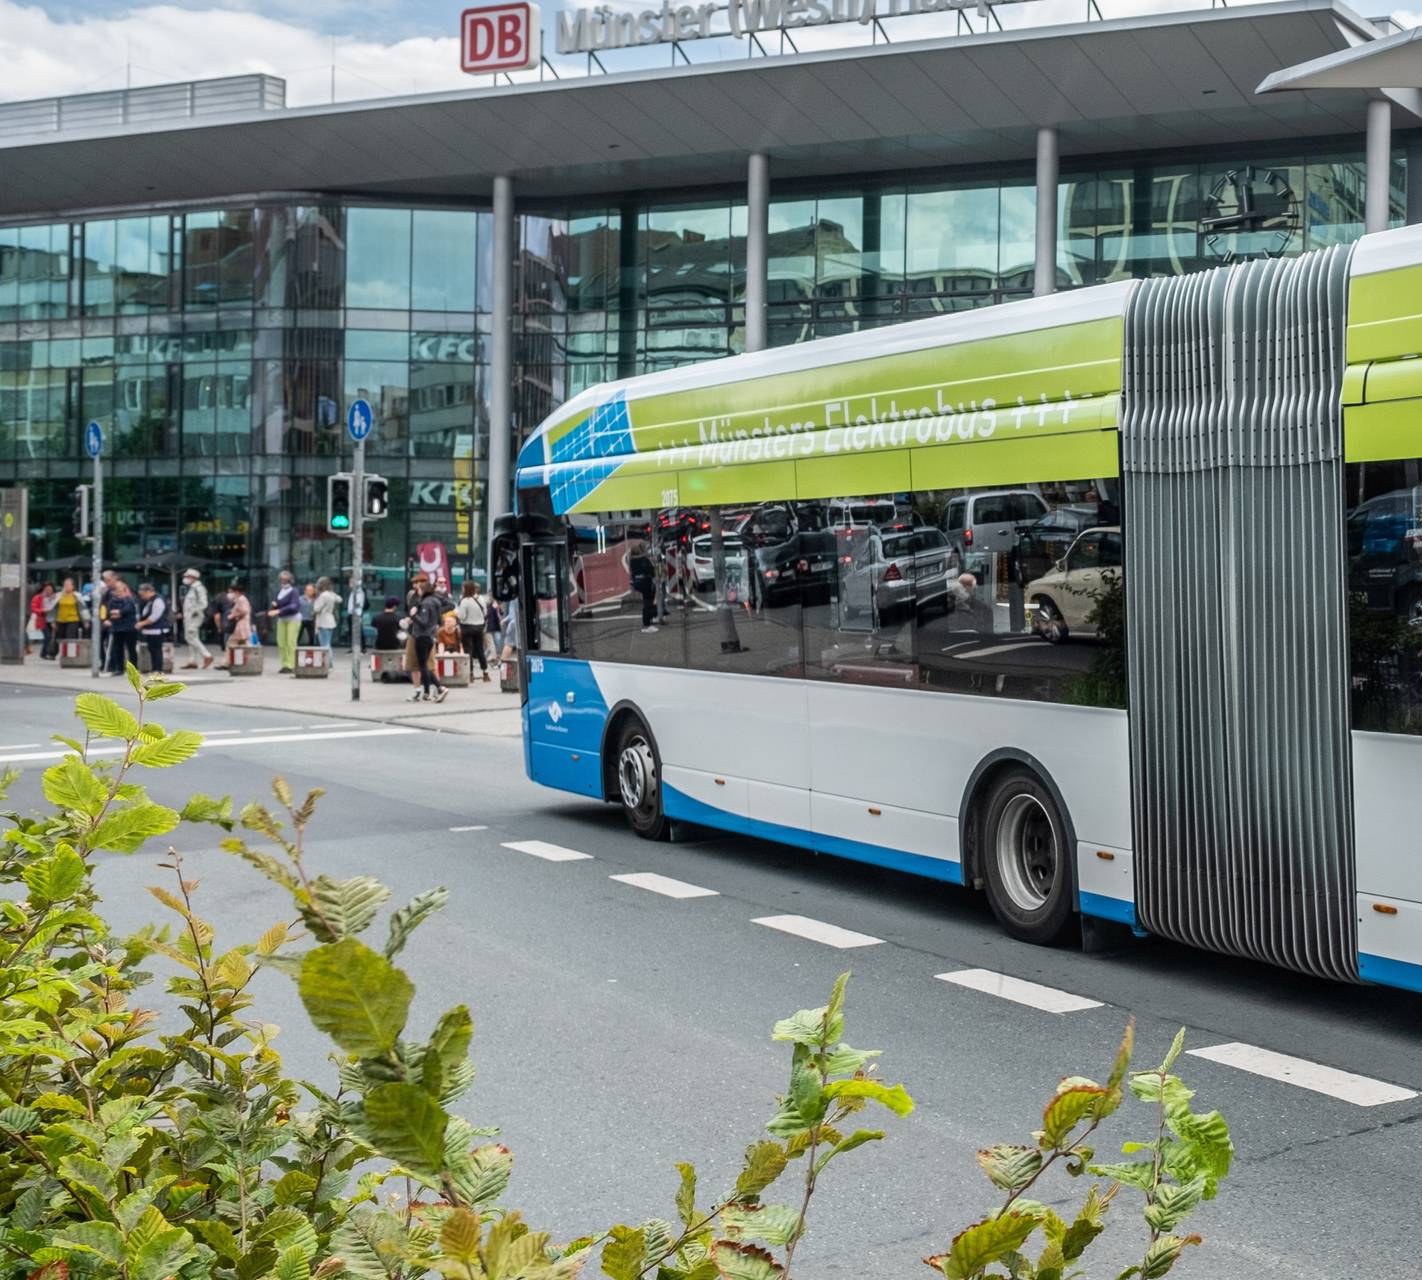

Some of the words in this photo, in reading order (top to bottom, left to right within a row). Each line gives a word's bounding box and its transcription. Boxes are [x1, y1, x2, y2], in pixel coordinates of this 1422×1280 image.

[469, 14, 522, 62] DB
[556, 0, 717, 54] Münster
[698, 417, 815, 465] Münsters
[823, 390, 997, 453] Elektrobus
